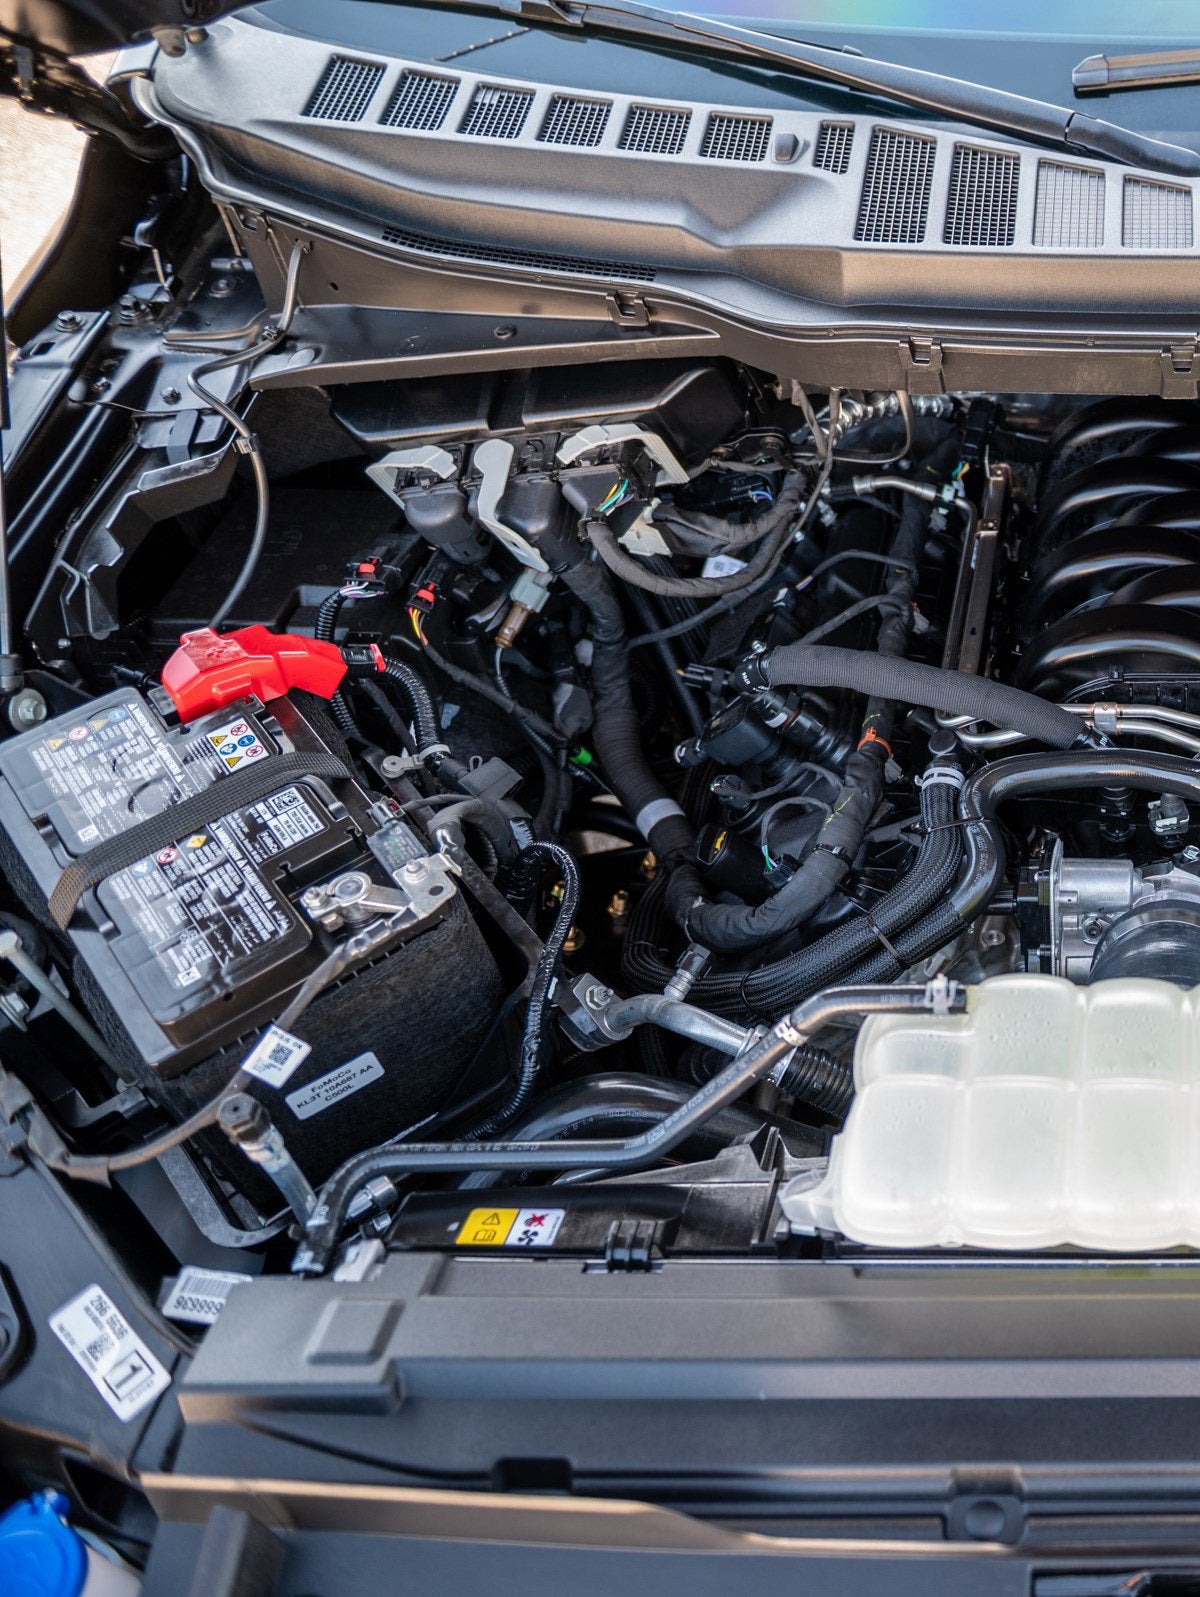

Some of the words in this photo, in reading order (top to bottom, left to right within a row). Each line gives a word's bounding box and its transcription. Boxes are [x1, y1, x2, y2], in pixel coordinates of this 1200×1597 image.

[296, 1092, 321, 1109] KL3T
[324, 1073, 356, 1094] 10A687
[359, 1064, 374, 1075] AA
[310, 1069, 352, 1092] FoMoCo
[324, 1085, 355, 1102] C500L
[89, 1295, 109, 1317] 266
[114, 1364, 143, 1390] 1
